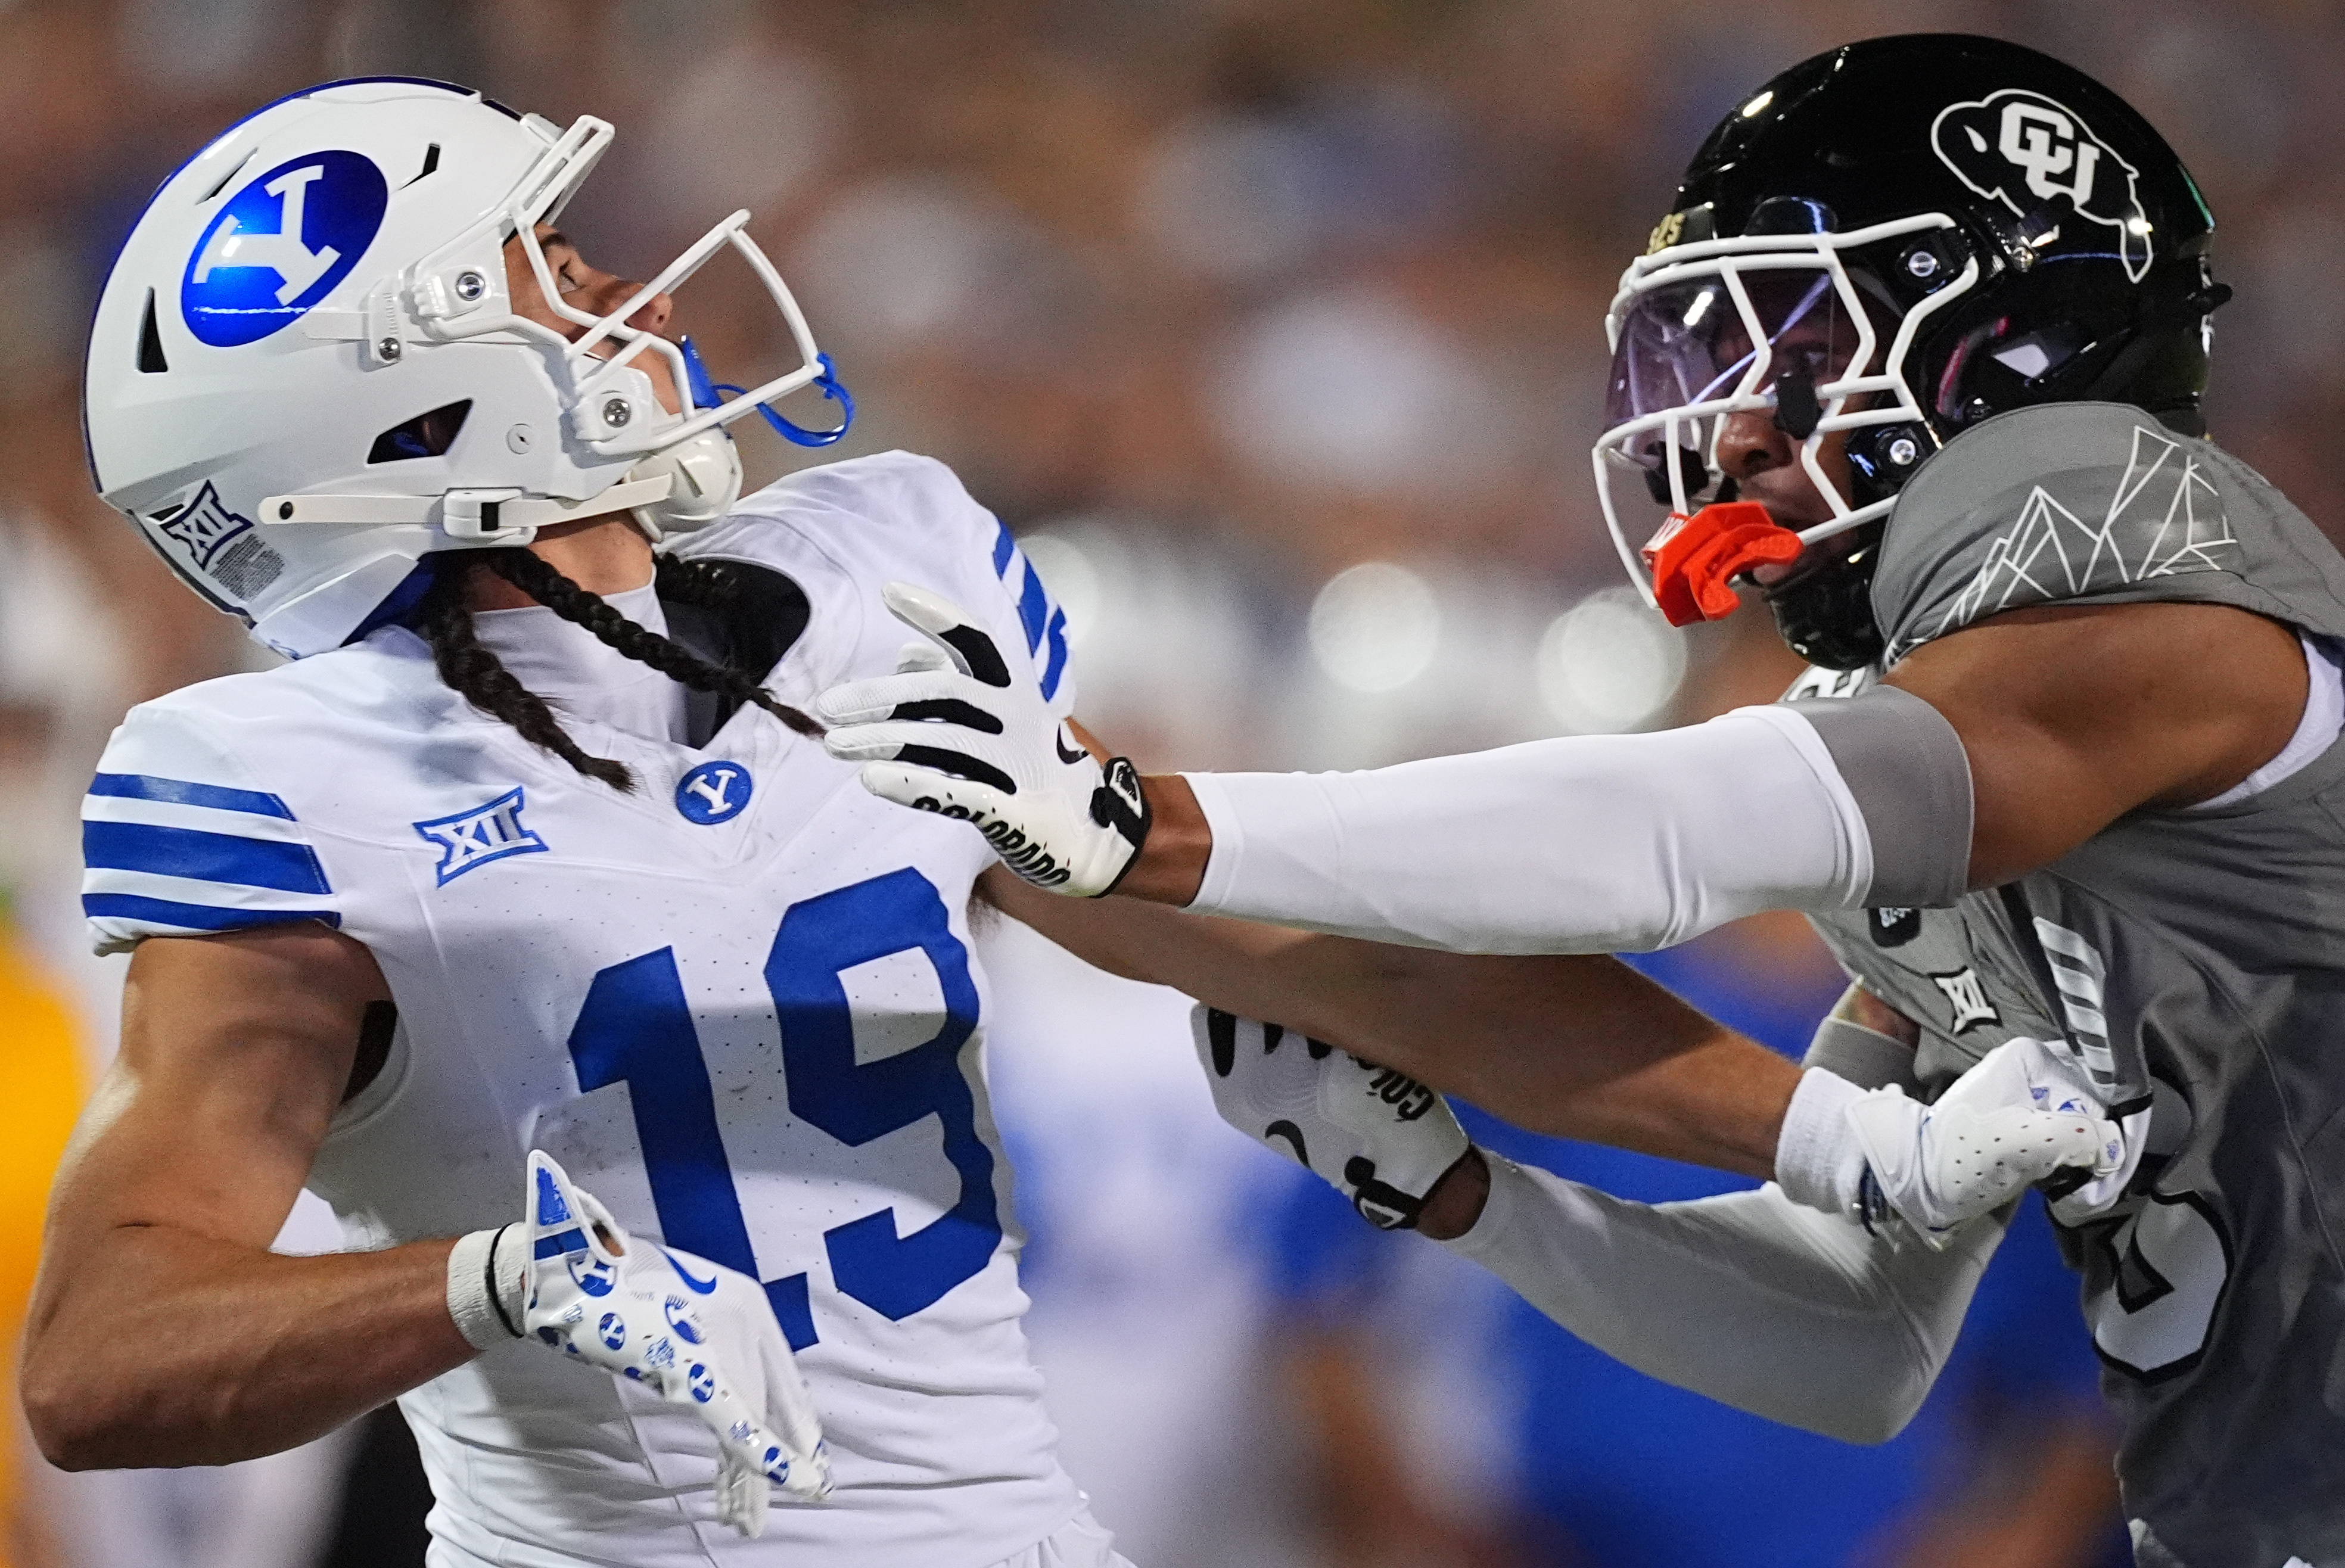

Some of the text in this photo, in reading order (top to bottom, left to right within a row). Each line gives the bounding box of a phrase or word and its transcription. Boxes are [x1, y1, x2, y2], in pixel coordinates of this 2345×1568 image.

[1999, 101, 2100, 207] CU
[189, 162, 344, 309] Y
[163, 483, 251, 568] XII
[416, 791, 545, 882] XII
[684, 767, 739, 817] Y
[1931, 967, 2000, 1035] XII
[566, 866, 1002, 1353] 19
